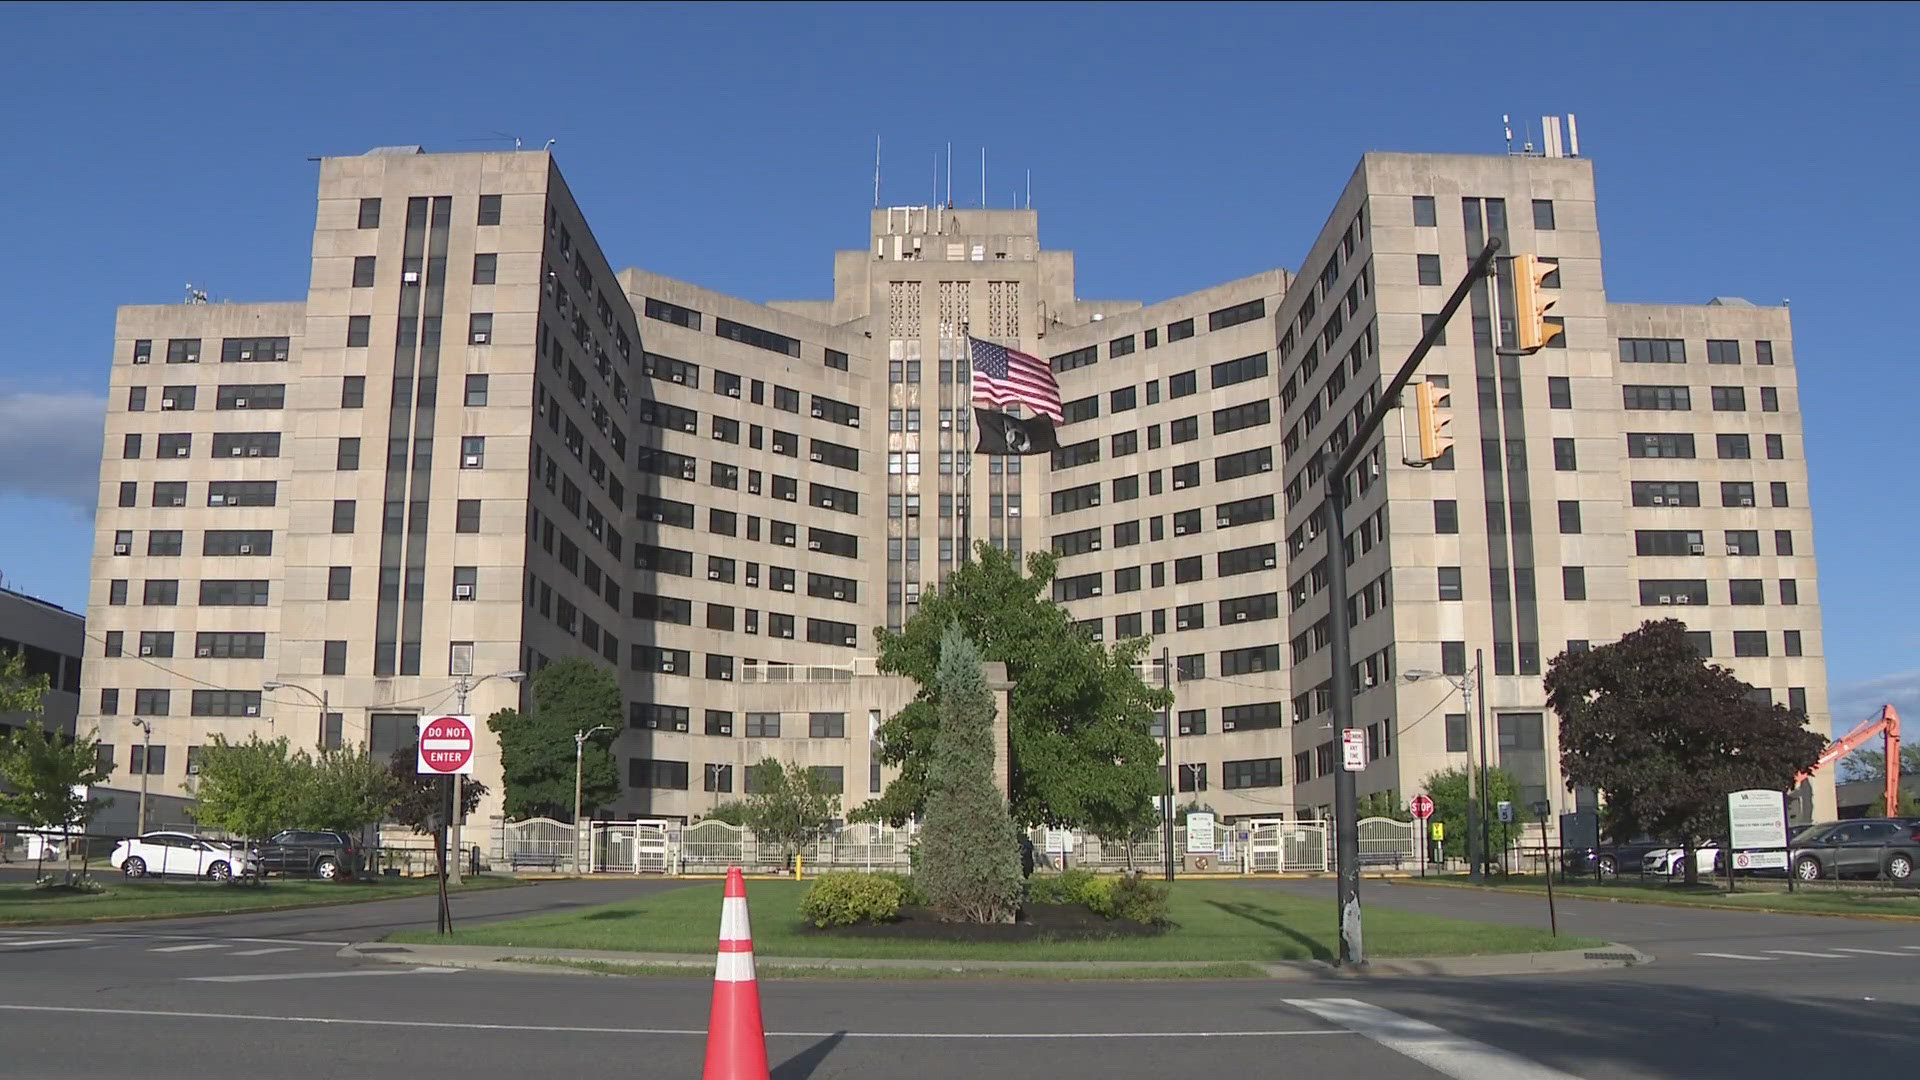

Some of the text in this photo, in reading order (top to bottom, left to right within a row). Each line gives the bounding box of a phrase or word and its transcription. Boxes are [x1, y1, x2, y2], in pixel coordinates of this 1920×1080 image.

[428, 727, 466, 737] DO NOT
[431, 752, 461, 762] ENTER
[1412, 802, 1431, 812] STOP
[1502, 811, 1508, 819] 5
